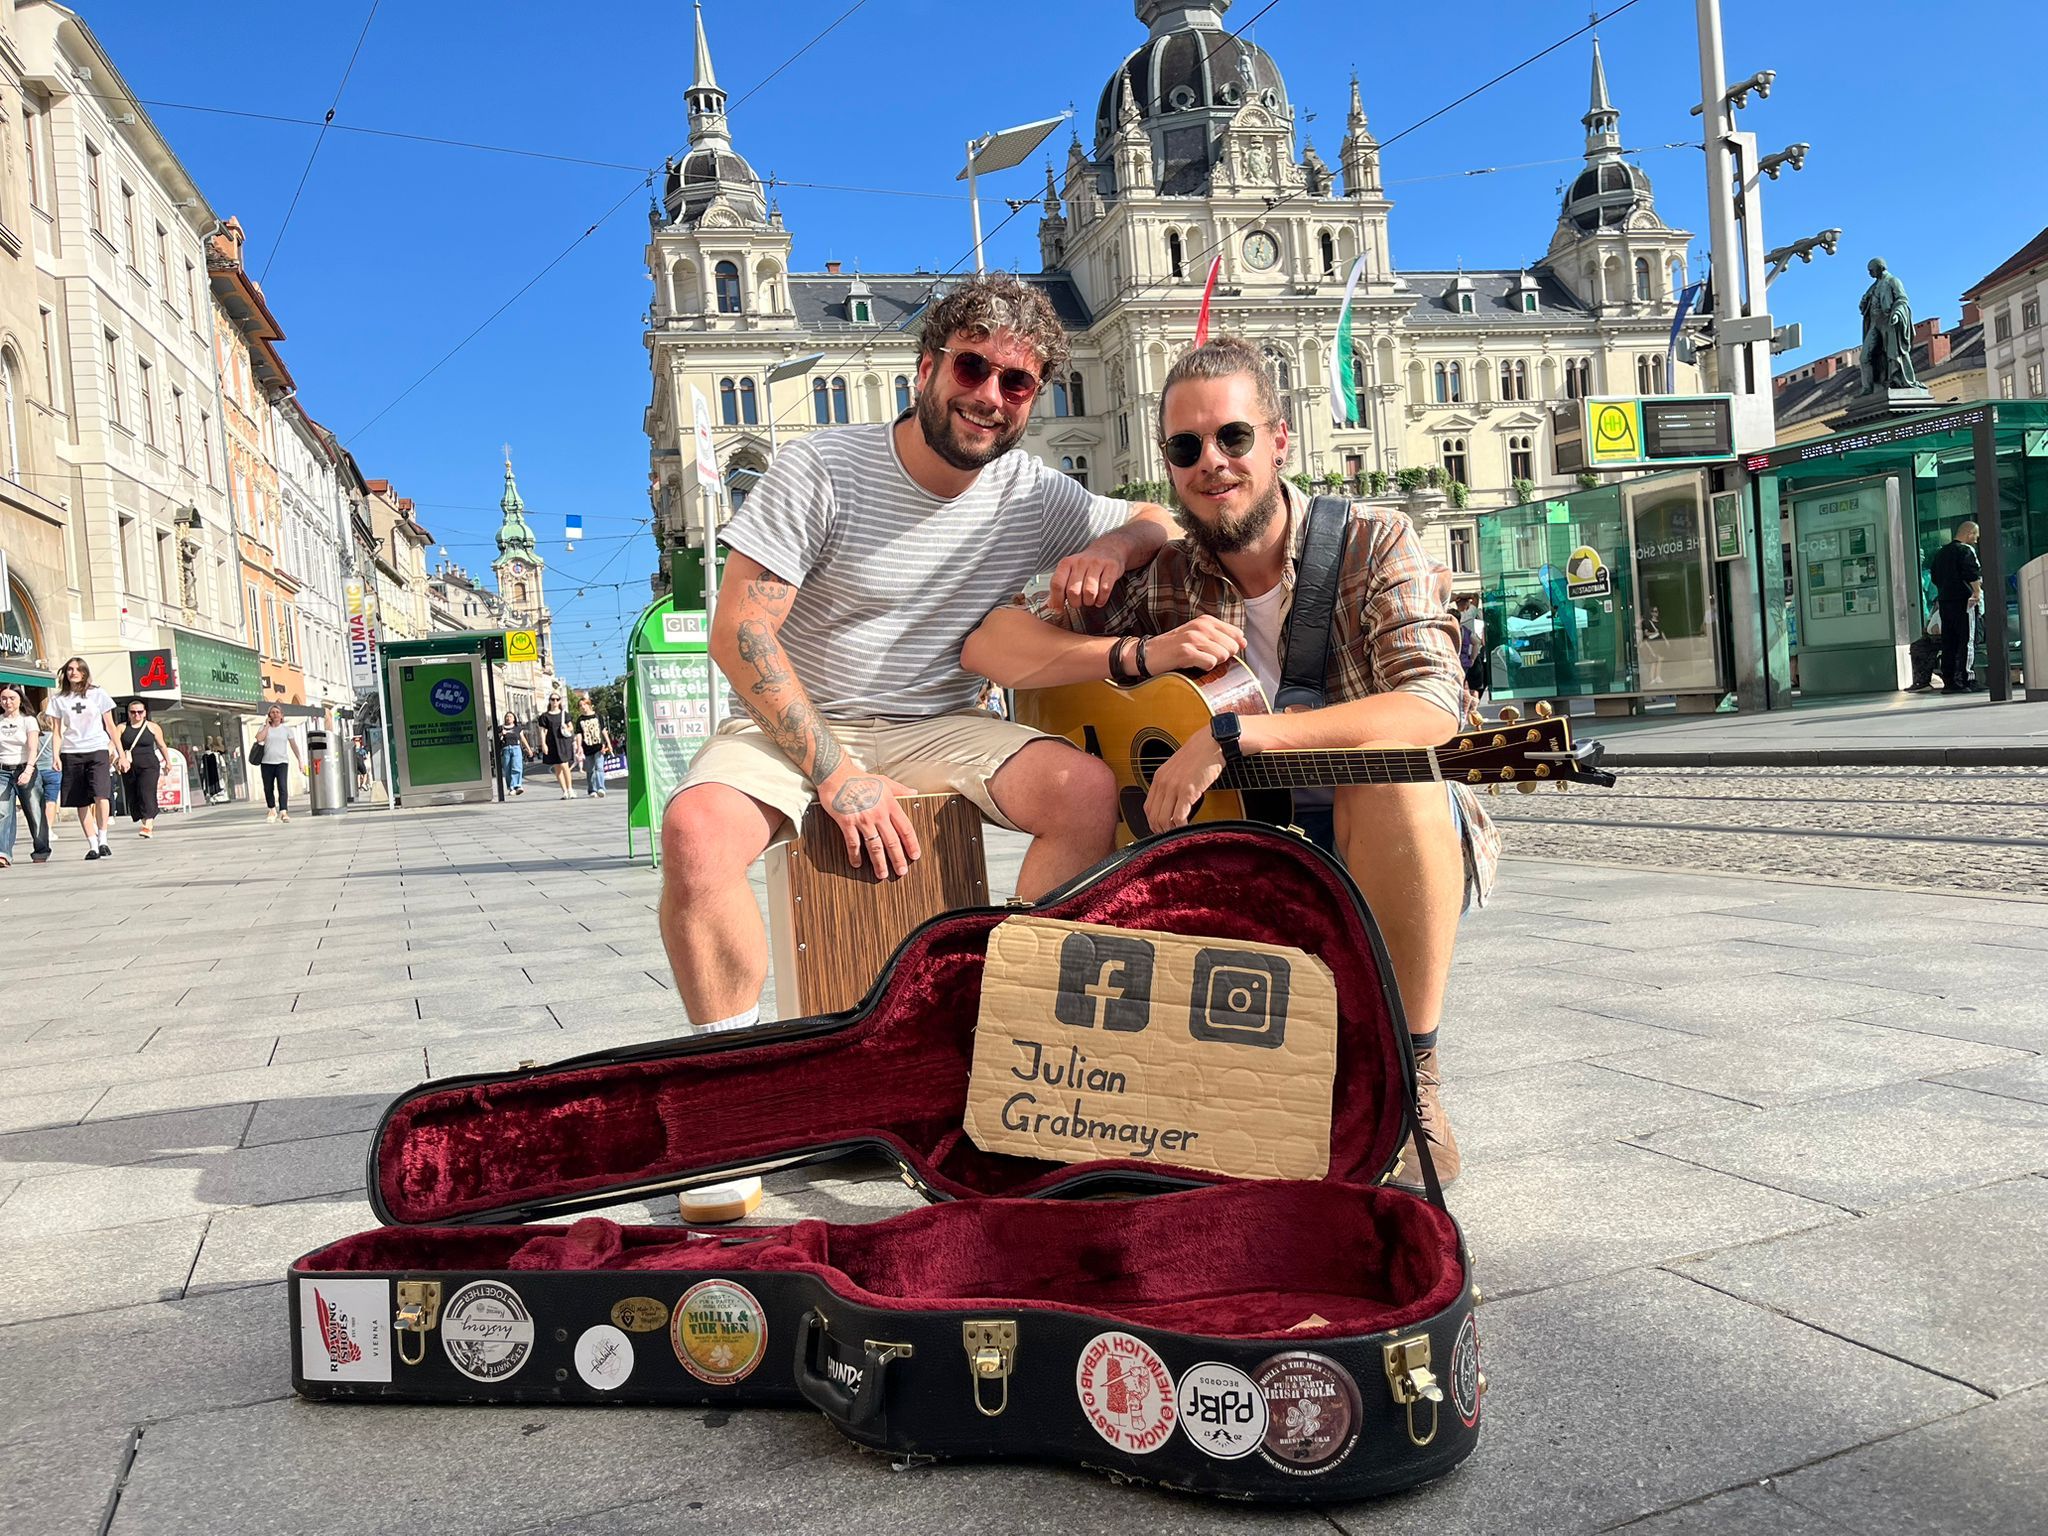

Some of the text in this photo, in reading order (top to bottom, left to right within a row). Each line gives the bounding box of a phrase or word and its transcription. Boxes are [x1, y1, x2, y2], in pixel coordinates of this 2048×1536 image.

[1820, 499, 1859, 515] GRAZ
[346, 585, 368, 666] HUMANIC
[14, 636, 33, 655] SHOP
[211, 669, 239, 685] PALMERS
[649, 661, 708, 679] Haltest
[679, 705, 687, 714] 4
[699, 704, 707, 713] 6
[660, 723, 702, 734] N1 N2
[1549, 737, 1563, 766] YAMA
[1011, 1039, 1126, 1093] Julian
[1001, 1092, 1199, 1157] Grabmayer
[463, 1287, 509, 1303] TOGETHER
[688, 1310, 749, 1323] MOLLY &
[462, 1314, 513, 1340] history
[689, 1323, 750, 1335] THE MEN
[329, 1302, 338, 1372] RED WING
[340, 1314, 348, 1360] SHOES
[489, 1360, 512, 1374] WRITE
[1081, 1337, 1173, 1403] HEIMLICH KEBAB
[1288, 1361, 1304, 1369] THE
[1200, 1377, 1239, 1388] RECORDS
[1285, 1374, 1313, 1382] FINEST
[1299, 1380, 1325, 1388] PARTY
[1264, 1384, 1337, 1400] IRISH FOLK
[1088, 1408, 1169, 1449] KICKL ISST
